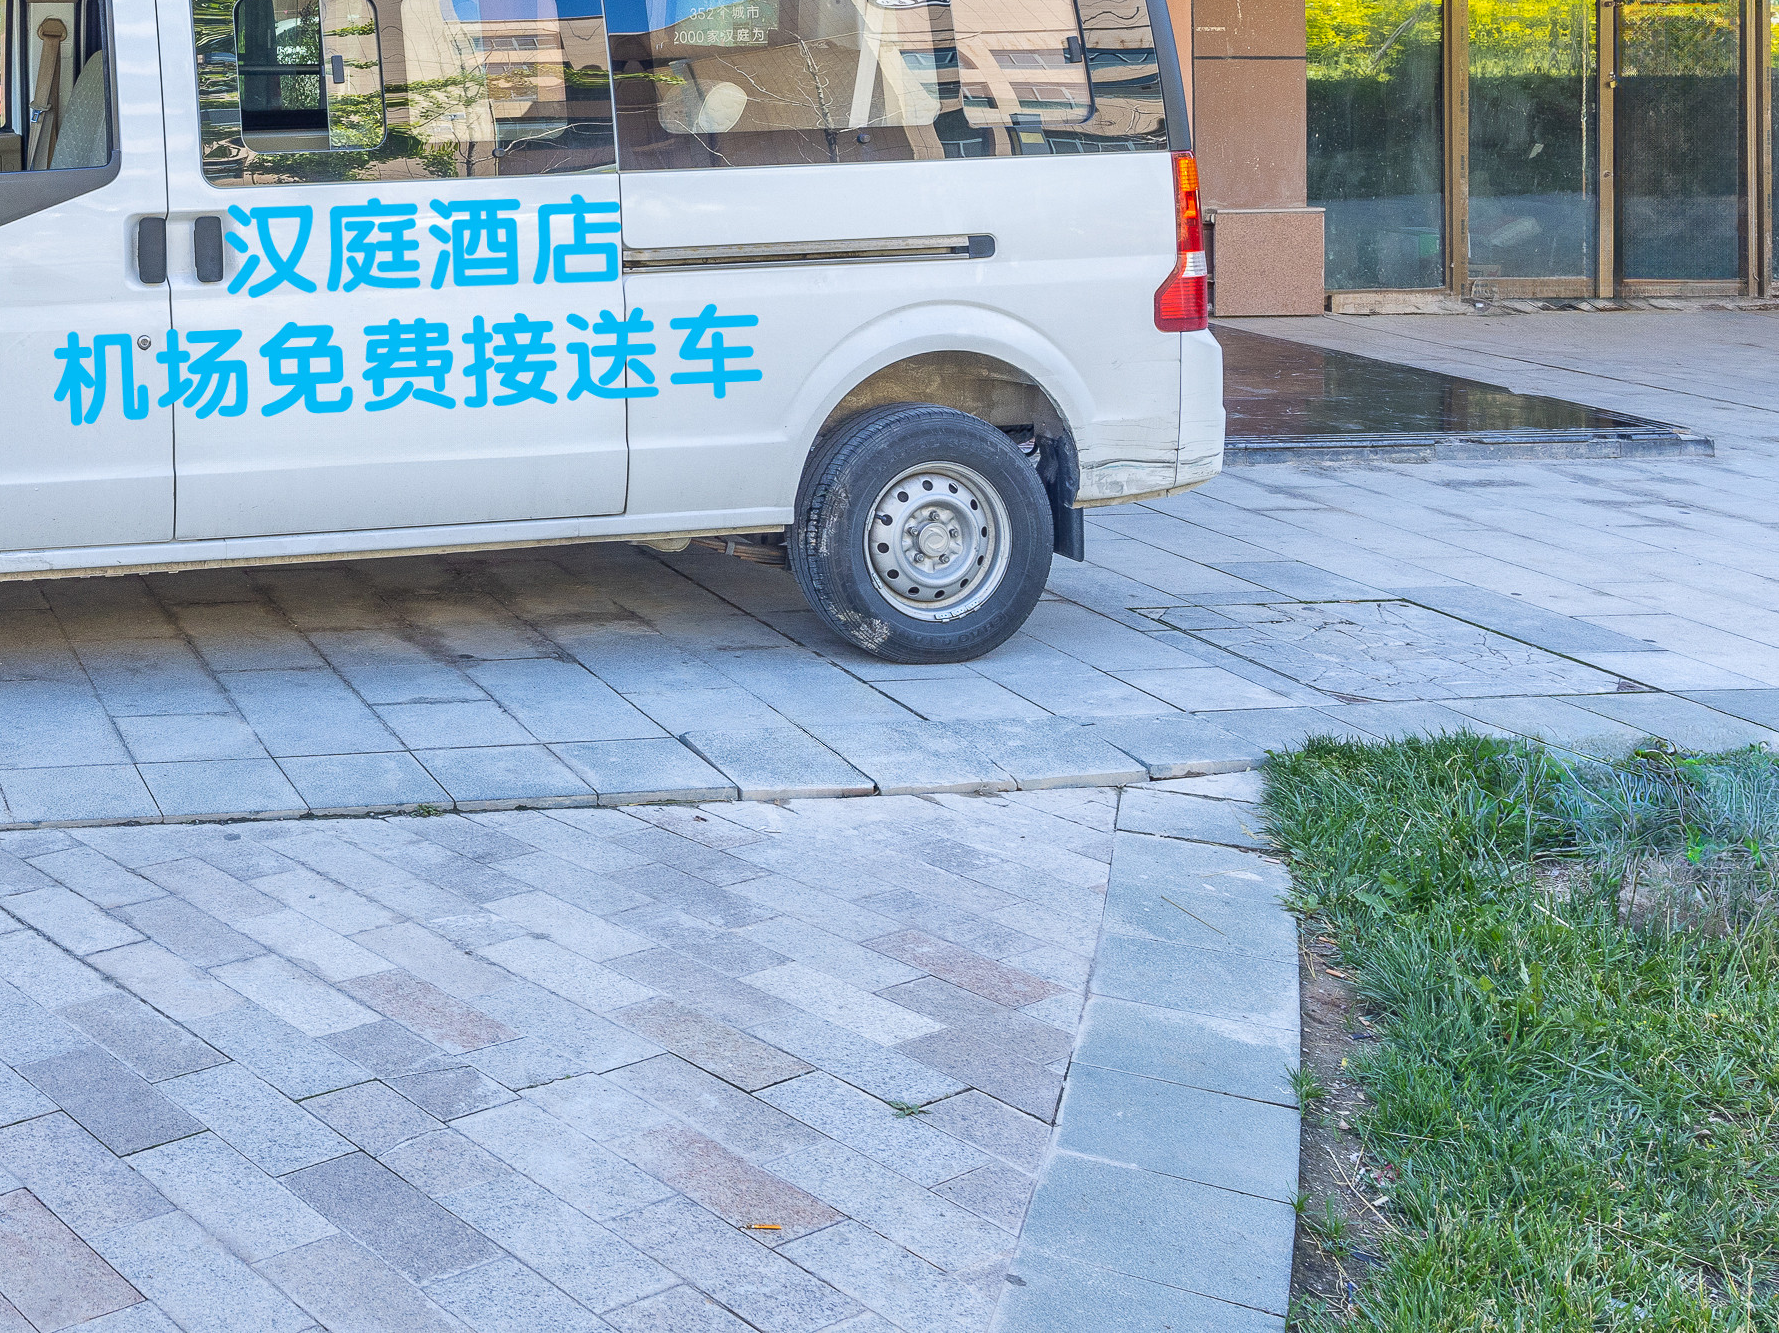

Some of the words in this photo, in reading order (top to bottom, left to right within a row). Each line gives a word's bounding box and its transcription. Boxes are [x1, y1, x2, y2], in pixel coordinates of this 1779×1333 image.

[674, 26, 778, 45] 2000家汉庭为
[225, 194, 621, 298] 汉庭酒店
[54, 303, 763, 426] 机场免费接送车
